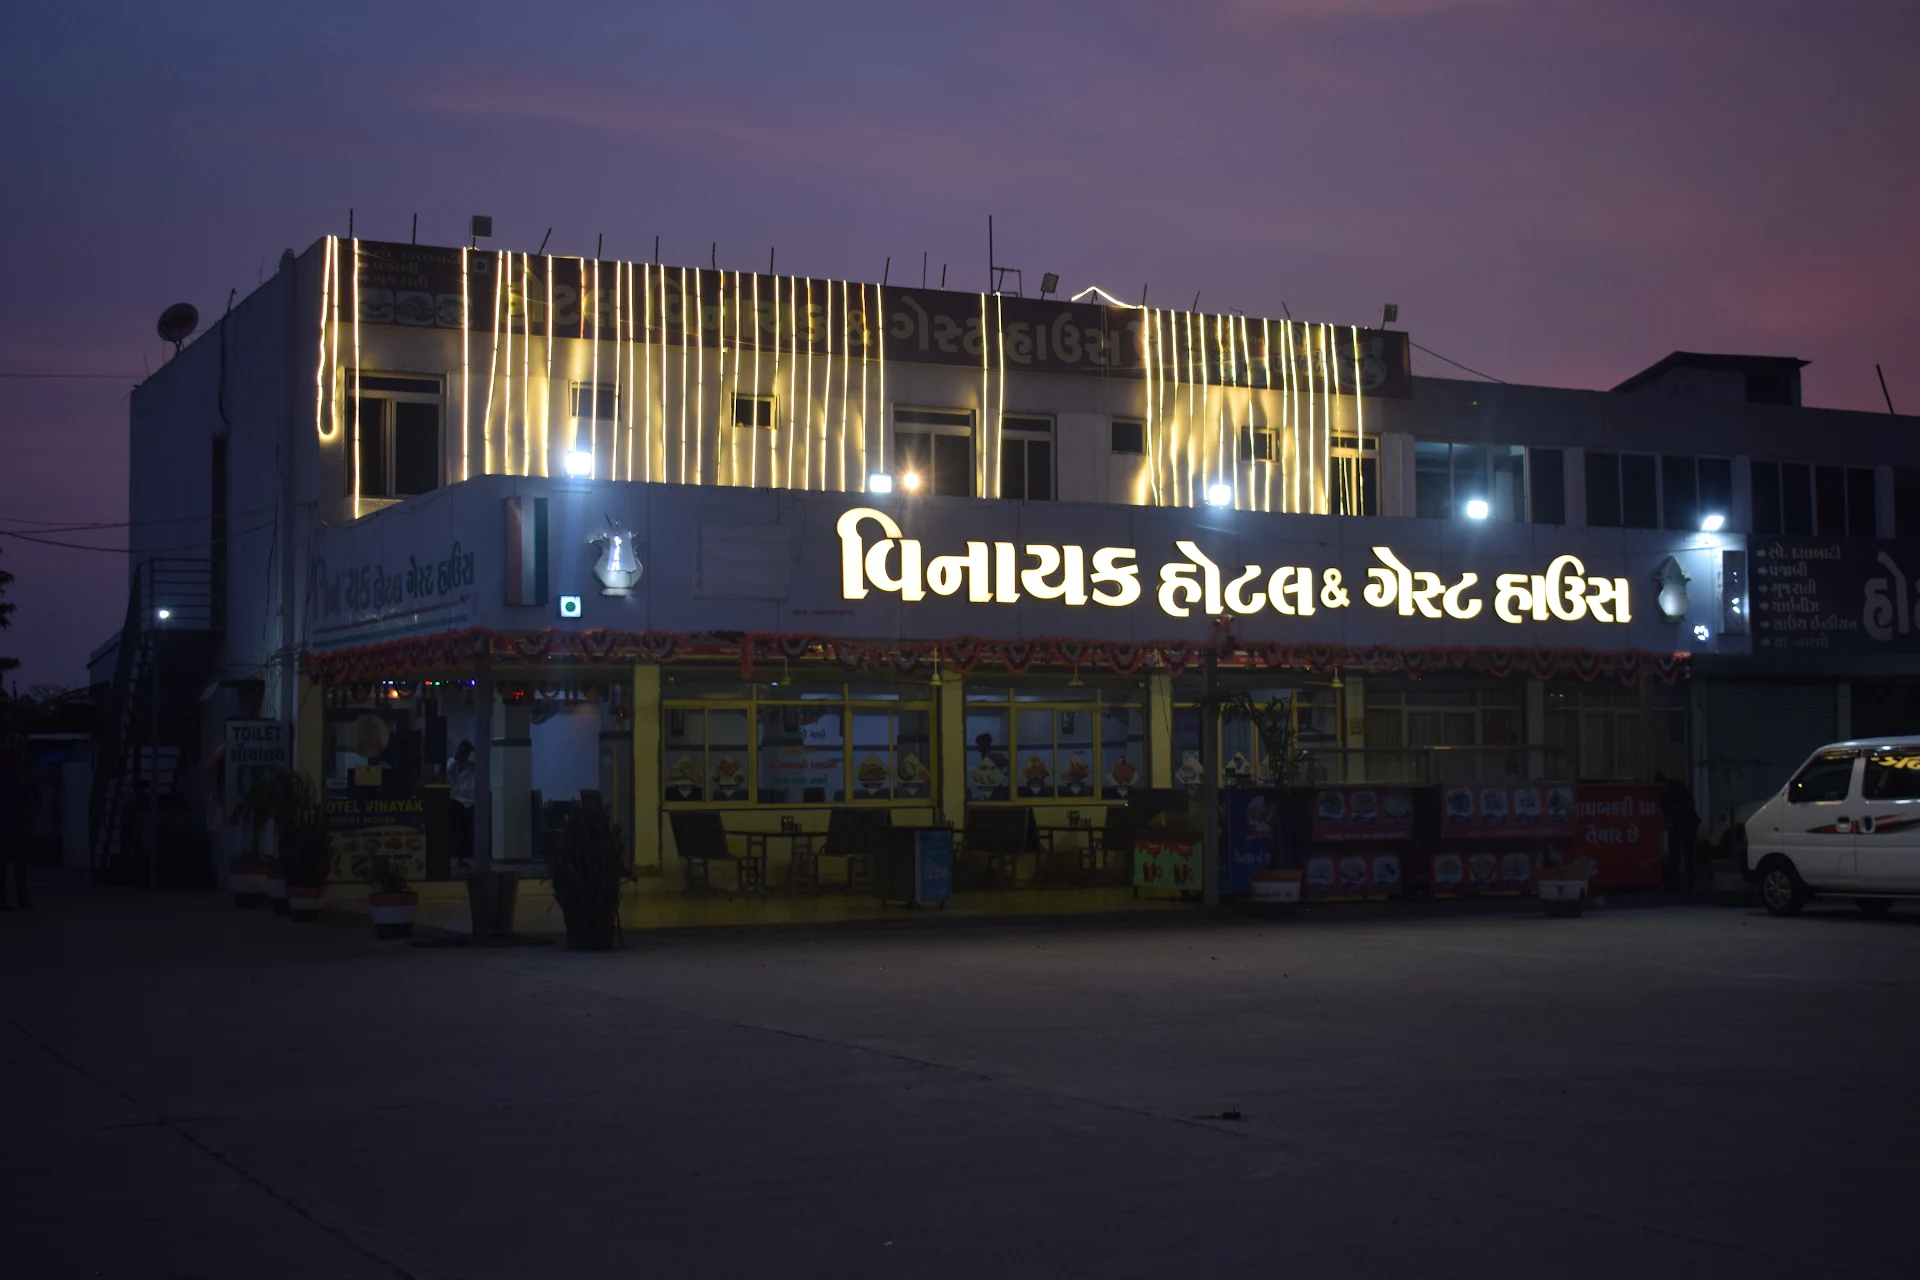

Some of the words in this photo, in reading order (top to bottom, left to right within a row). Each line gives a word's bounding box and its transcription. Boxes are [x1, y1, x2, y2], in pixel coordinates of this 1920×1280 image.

[650, 273, 828, 344] વિનાયક
[890, 295, 989, 356] ગેસ્ટ
[1006, 312, 1122, 367] હાઉસ
[836, 506, 1141, 607] વિનાયક
[1158, 540, 1316, 617] હોટલ
[1320, 567, 1350, 609] &
[1363, 546, 1483, 619] ગેસ્ટ
[1494, 554, 1632, 624] હાઉસ
[1769, 560, 1808, 577] પંજાબી
[313, 557, 370, 619] વિનયક
[406, 554, 434, 599] ગેસ્ટ
[437, 541, 475, 596] હાઉસ
[1770, 578, 1817, 599] ગુજરાતી
[1863, 550, 1920, 641] હો
[231, 725, 284, 742] TOILET
[230, 743, 285, 762] શૌચાલય
[326, 800, 362, 814] OTEL
[364, 799, 424, 813] VINAYAK
[1575, 796, 1634, 817] ાઘબકરી
[1637, 800, 1656, 817] ચા
[363, 815, 397, 826] HOUSE
[1585, 821, 1623, 844] તૈયાર
[1626, 821, 1640, 843] છે
